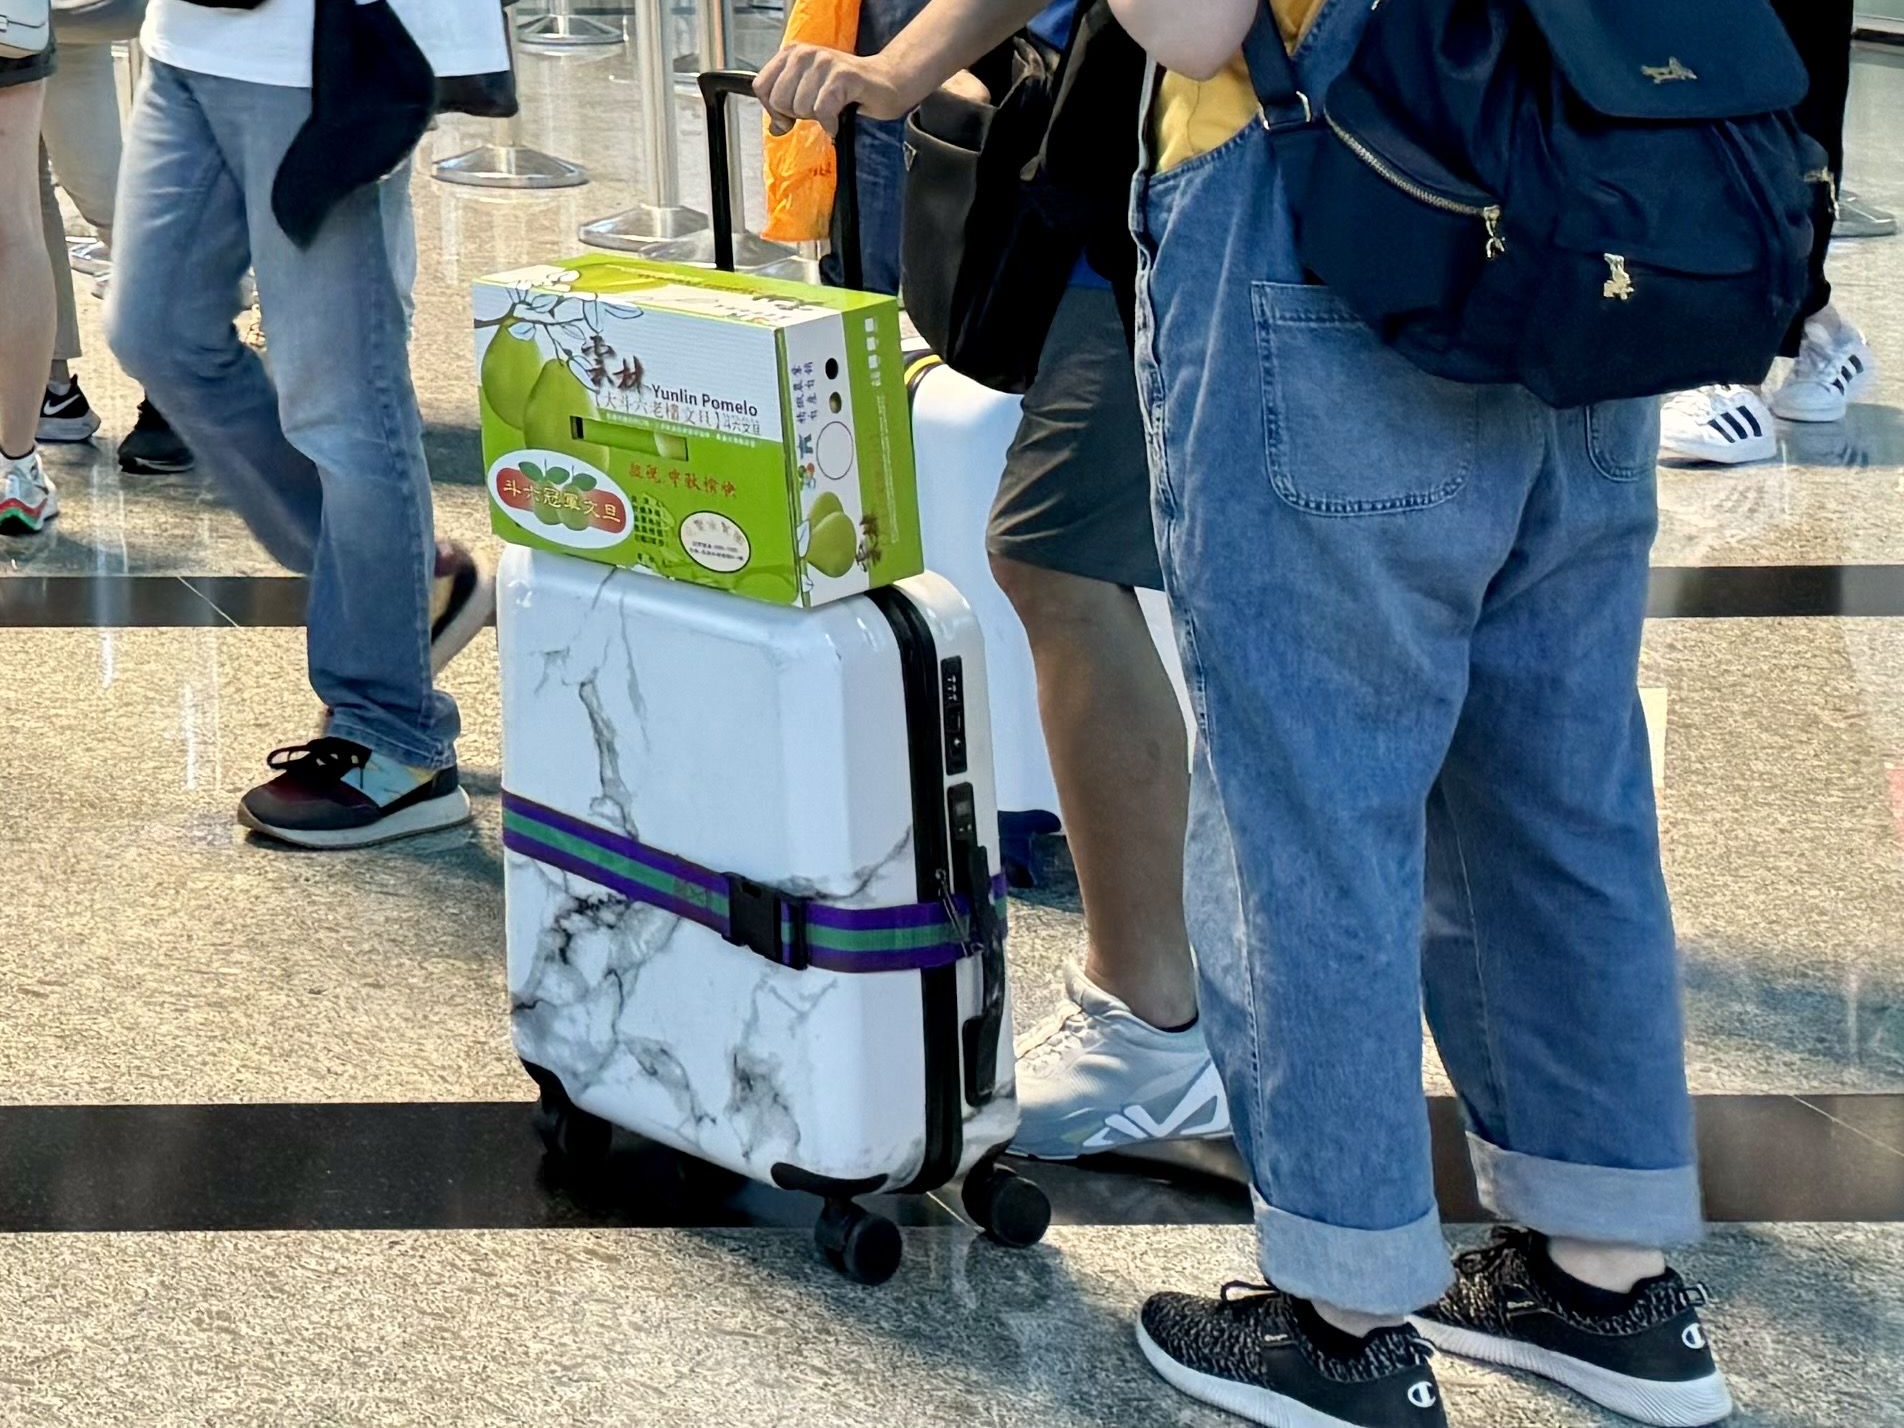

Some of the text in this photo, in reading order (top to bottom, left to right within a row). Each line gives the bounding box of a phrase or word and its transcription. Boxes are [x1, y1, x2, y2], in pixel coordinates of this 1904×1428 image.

[652, 384, 697, 405] Yunlin
[702, 394, 758, 417] Pomelo
[503, 479, 621, 523] 斗六冠軍文旦
